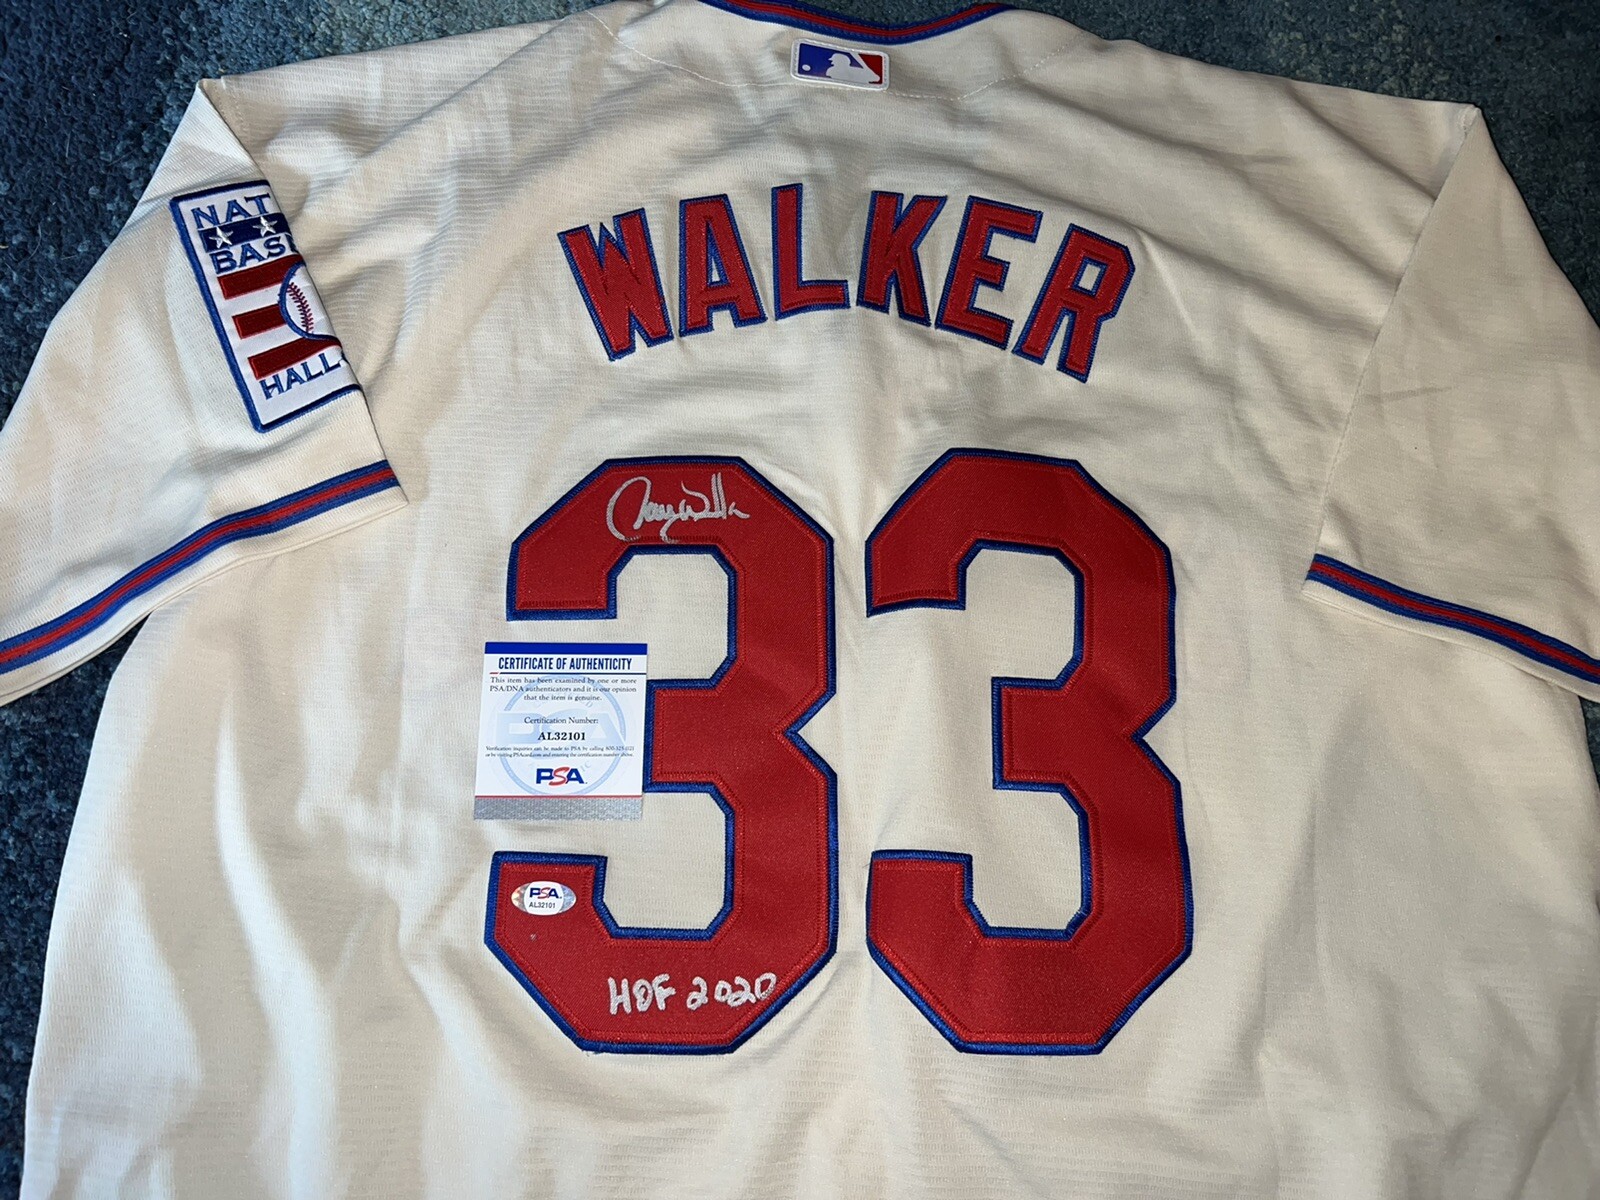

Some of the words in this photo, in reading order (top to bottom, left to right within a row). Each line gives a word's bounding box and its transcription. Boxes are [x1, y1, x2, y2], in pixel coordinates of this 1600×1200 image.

[557, 183, 1135, 383] WALKER
[259, 353, 342, 400] HALL
[498, 657, 553, 670] CERTIFICATE
[556, 657, 567, 670] OF
[569, 657, 632, 670] AUTHENTICITY
[587, 677, 595, 685] by
[537, 732, 586, 741] AL32101
[536, 766, 586, 786] PSA
[529, 886, 560, 899] PSA
[528, 901, 556, 909] AL32101
[608, 973, 676, 1015] HOF
[686, 972, 778, 1012] 2020
